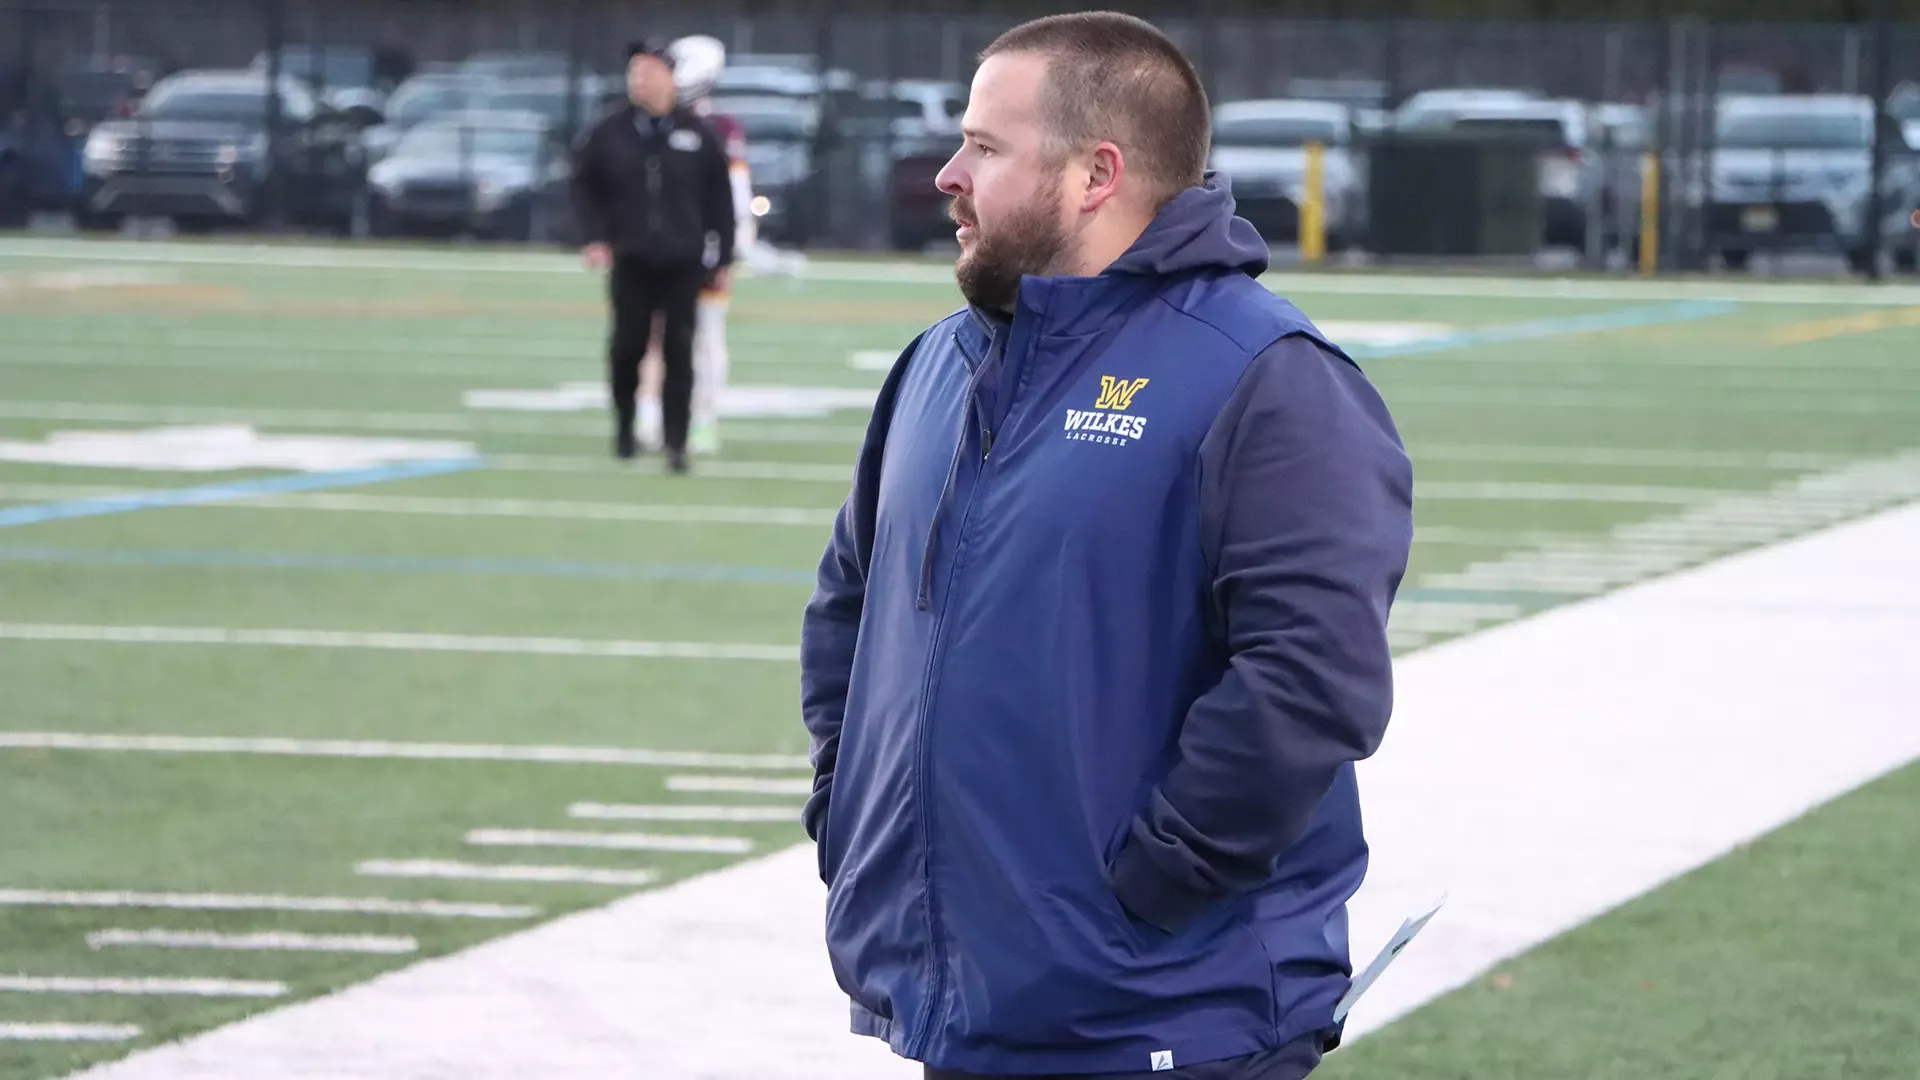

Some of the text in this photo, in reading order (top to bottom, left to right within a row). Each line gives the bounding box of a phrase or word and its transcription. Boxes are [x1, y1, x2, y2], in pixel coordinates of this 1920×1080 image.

[1095, 375, 1150, 410] W
[1064, 409, 1147, 440] WILKES
[1066, 432, 1127, 446] LACROSSE
